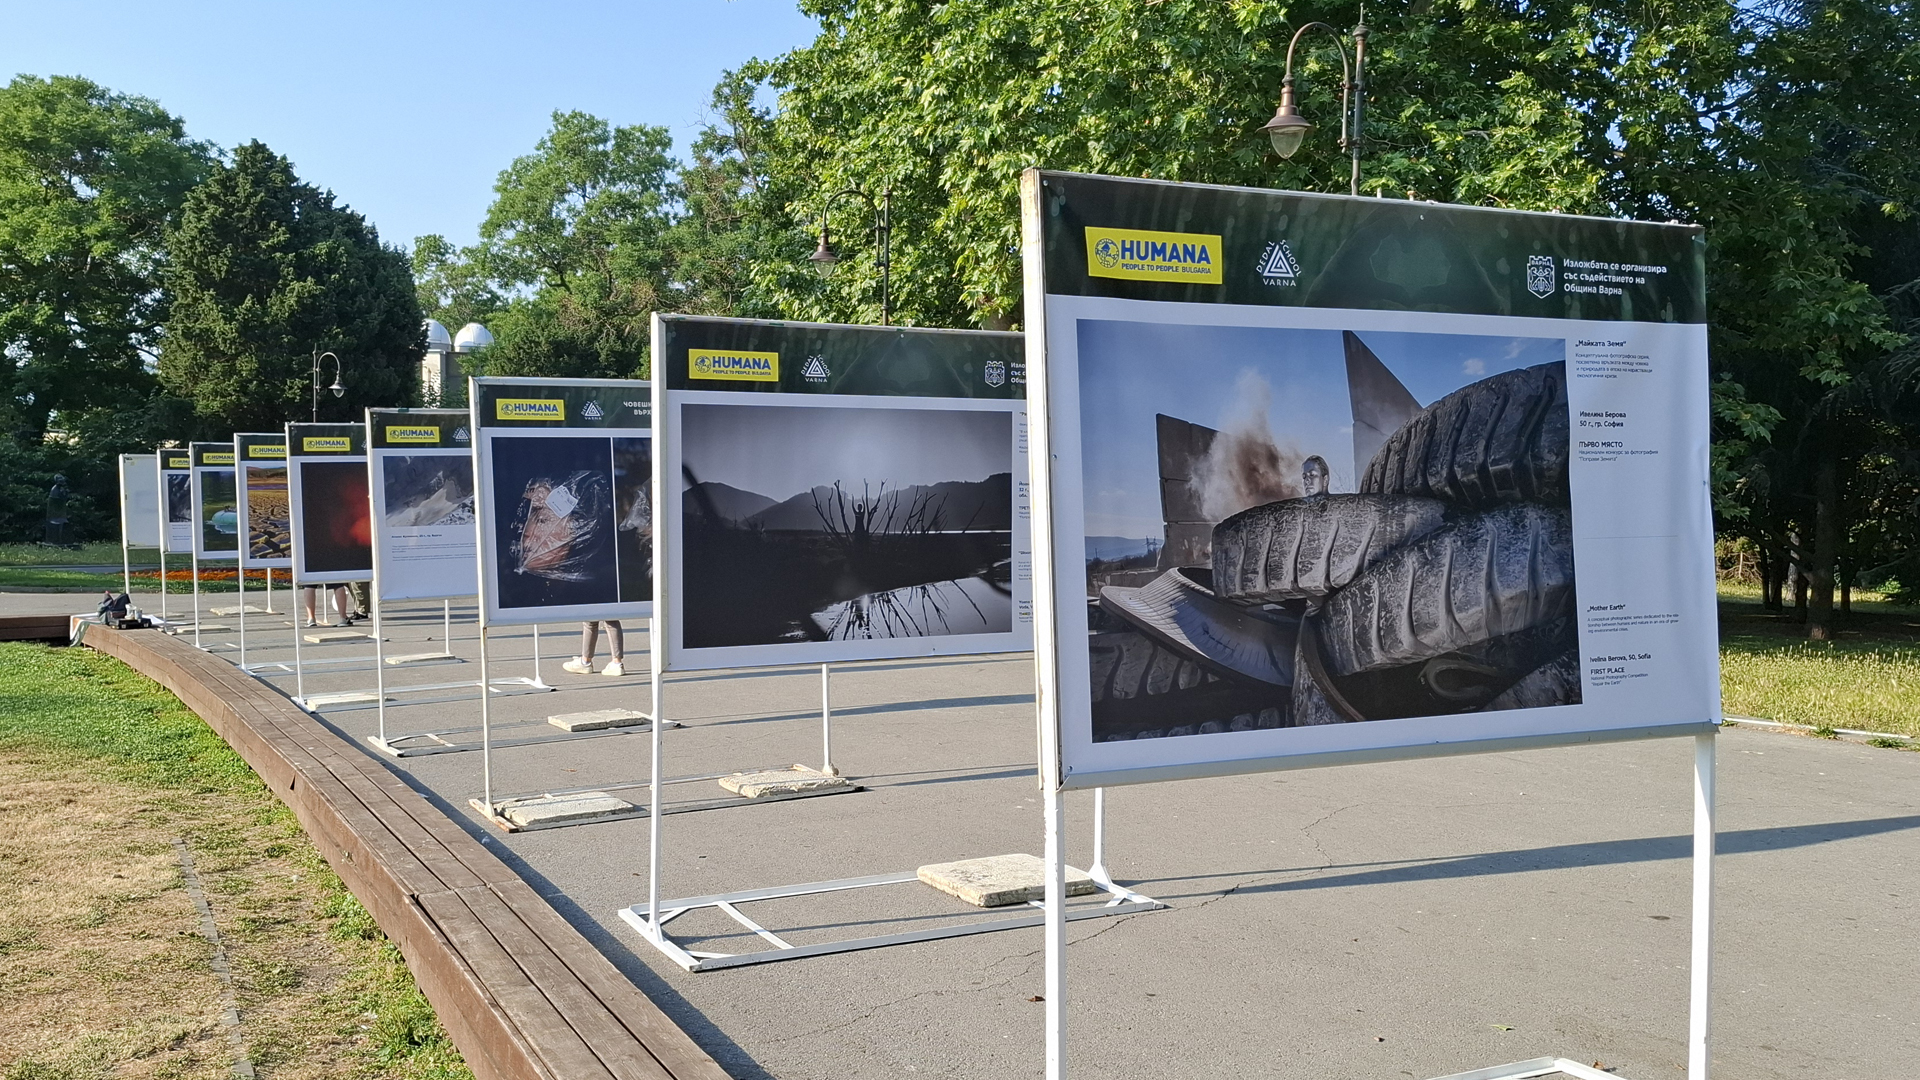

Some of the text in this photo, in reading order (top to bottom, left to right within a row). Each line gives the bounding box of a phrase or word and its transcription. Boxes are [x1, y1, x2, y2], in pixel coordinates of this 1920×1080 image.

[1121, 240, 1211, 264] HUMANA
[1256, 241, 1275, 273] DEDAL
[1280, 240, 1302, 277] SCHOOL
[1564, 258, 1608, 270] Изложбата
[1621, 264, 1667, 274] организира
[1263, 278, 1296, 286] VARNA
[1580, 274, 1633, 284] съдействието
[1564, 284, 1622, 296] Община Варна
[712, 356, 771, 370] HUMANA
[514, 404, 558, 412] HUMANA
